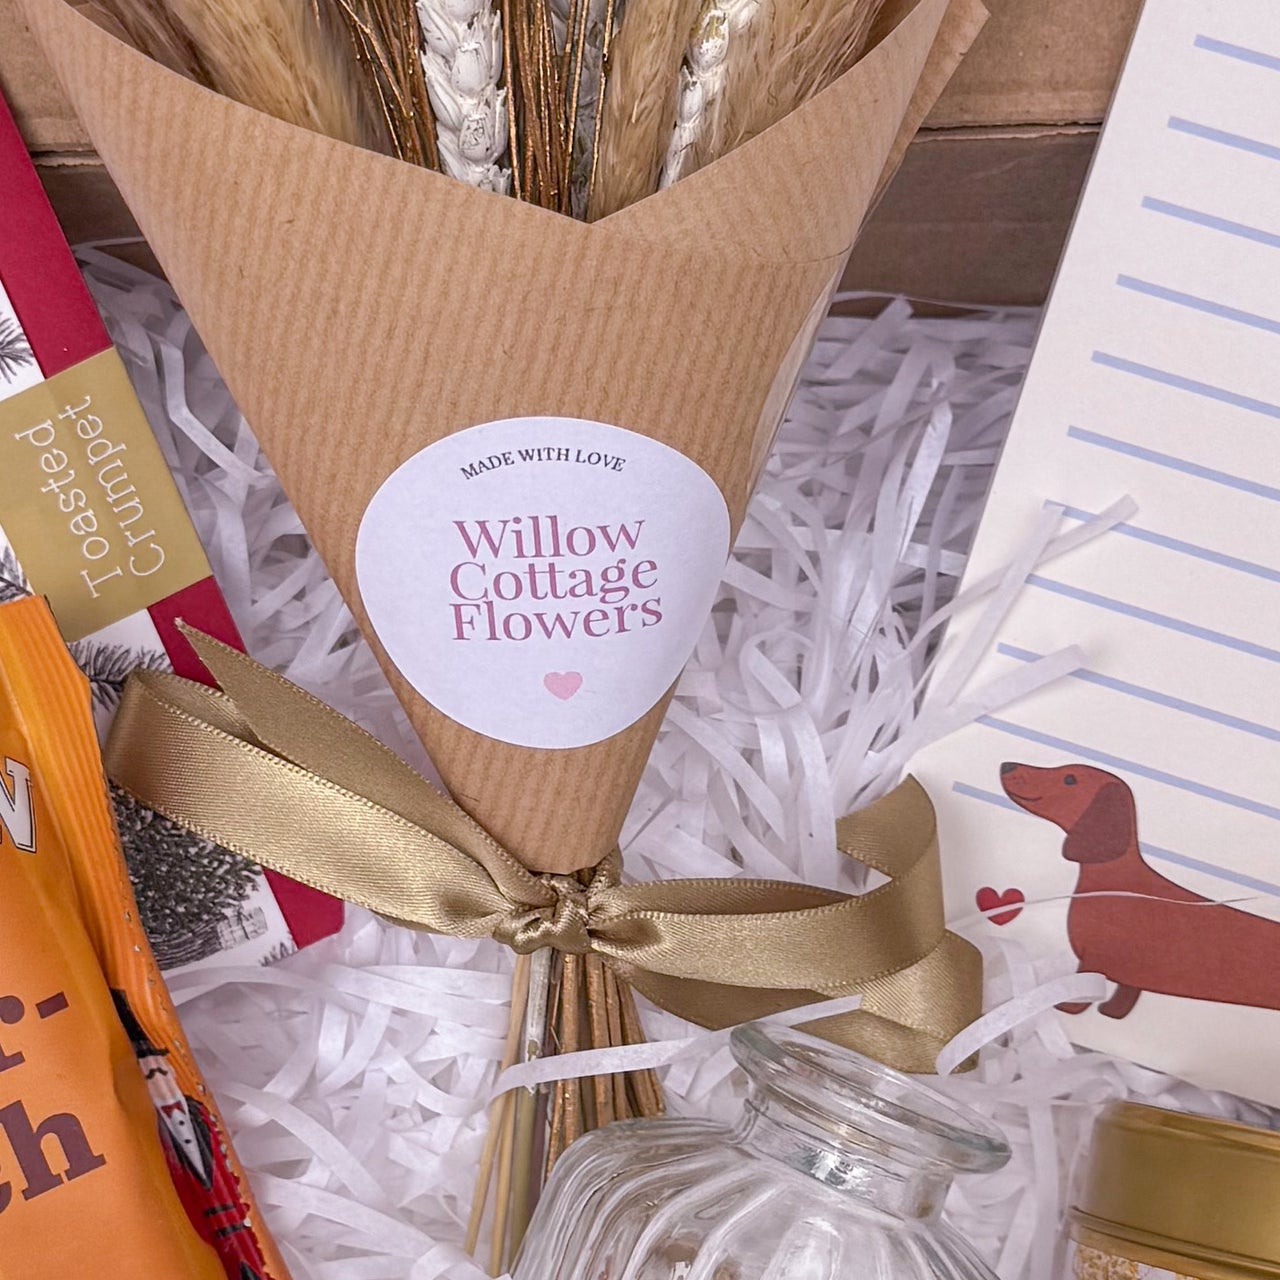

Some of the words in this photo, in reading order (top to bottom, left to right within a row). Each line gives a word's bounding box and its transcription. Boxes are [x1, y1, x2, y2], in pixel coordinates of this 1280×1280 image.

[59, 395, 165, 576] Crumpet
[460, 451, 515, 480] MADE
[517, 447, 570, 462] WITH
[575, 449, 626, 472] LOVE
[14, 419, 124, 599] Toasted
[452, 515, 645, 559] Willow
[449, 558, 659, 604] Cottage
[449, 597, 664, 641] Flowers
